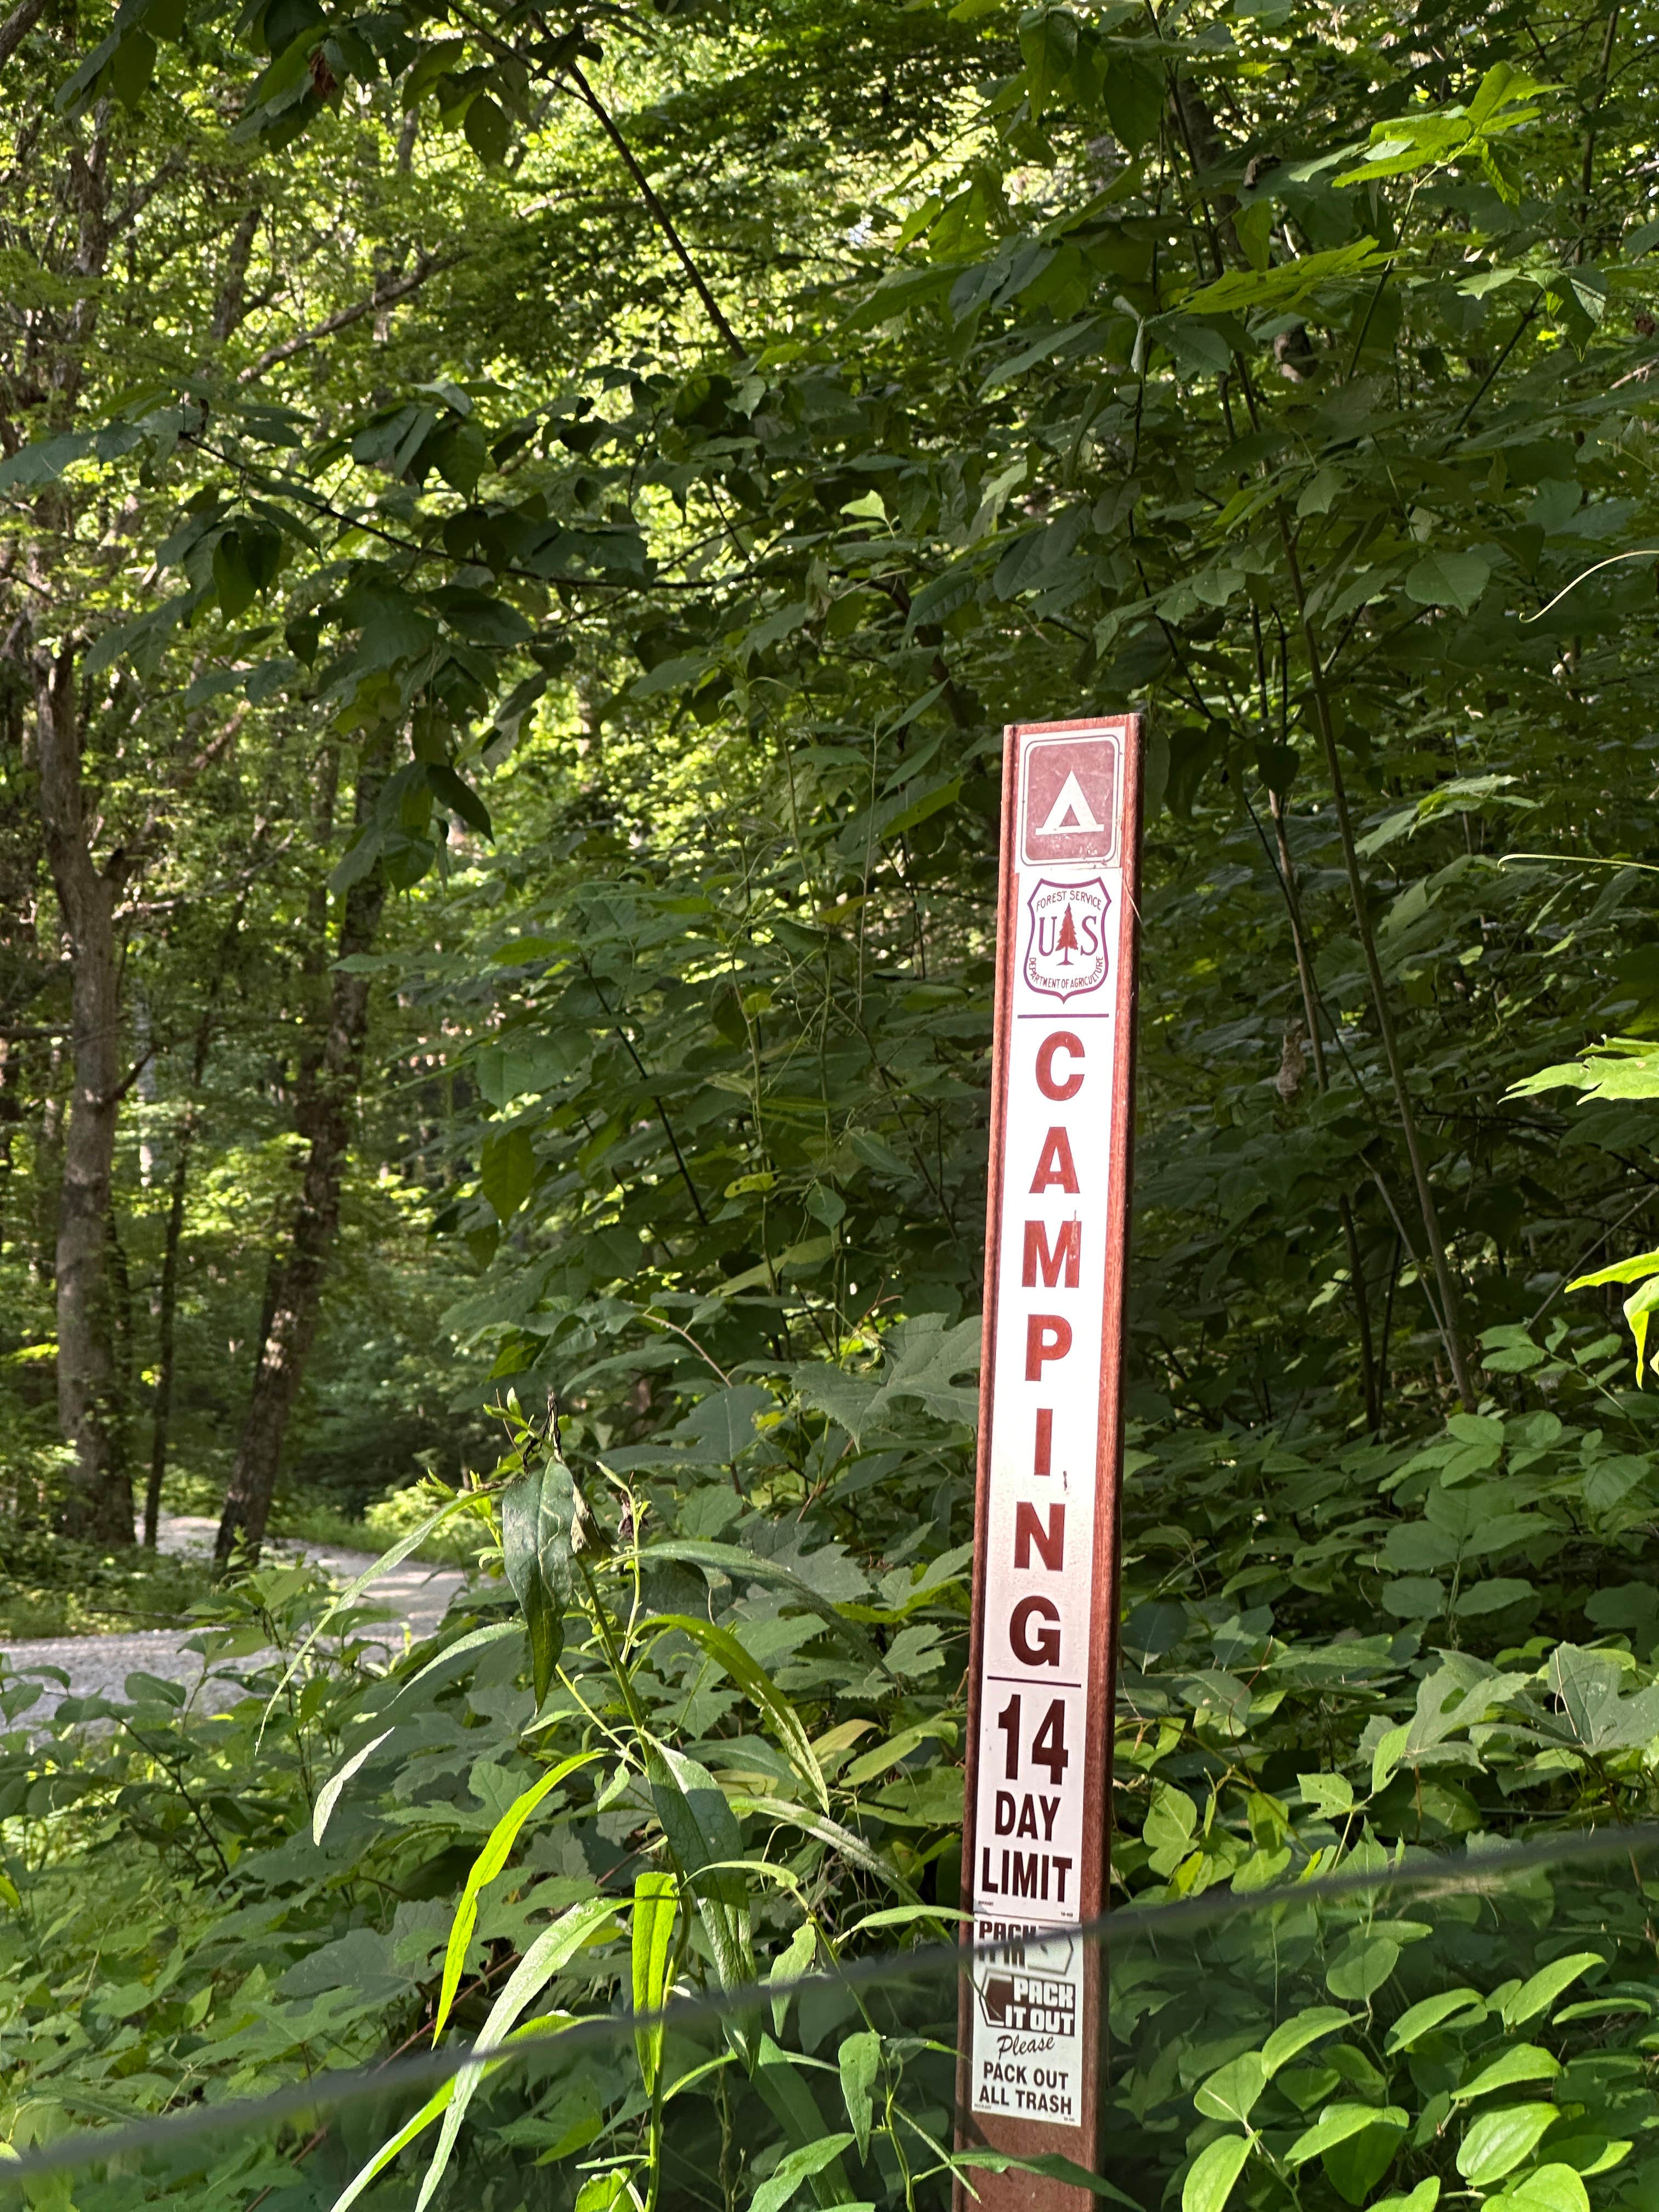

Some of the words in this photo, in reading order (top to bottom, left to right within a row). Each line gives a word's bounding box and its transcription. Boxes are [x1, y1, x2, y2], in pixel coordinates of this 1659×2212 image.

[1037, 891, 1067, 912] FOREST
[1070, 890, 1102, 911] SERVICE
[1029, 957, 1060, 988] DEPARTMENT
[1062, 978, 1069, 989] OF
[1070, 956, 1103, 988] AGRICULTURE
[1009, 1031, 1085, 1667] CAMPING
[998, 1694, 1068, 1785] 14
[994, 1790, 1061, 1842] DAY
[981, 1847, 1072, 1903] LIMIT
[1014, 1977, 1073, 2008] PACK
[1006, 2005, 1026, 2029] IT
[1030, 2008, 1074, 2034] OUT
[997, 2034, 1056, 2059] Please
[984, 2061, 1027, 2085] PACK
[1034, 2068, 1069, 2090] OUT
[979, 2085, 1009, 2106] ALL
[1015, 2089, 1072, 2115] TRASH
